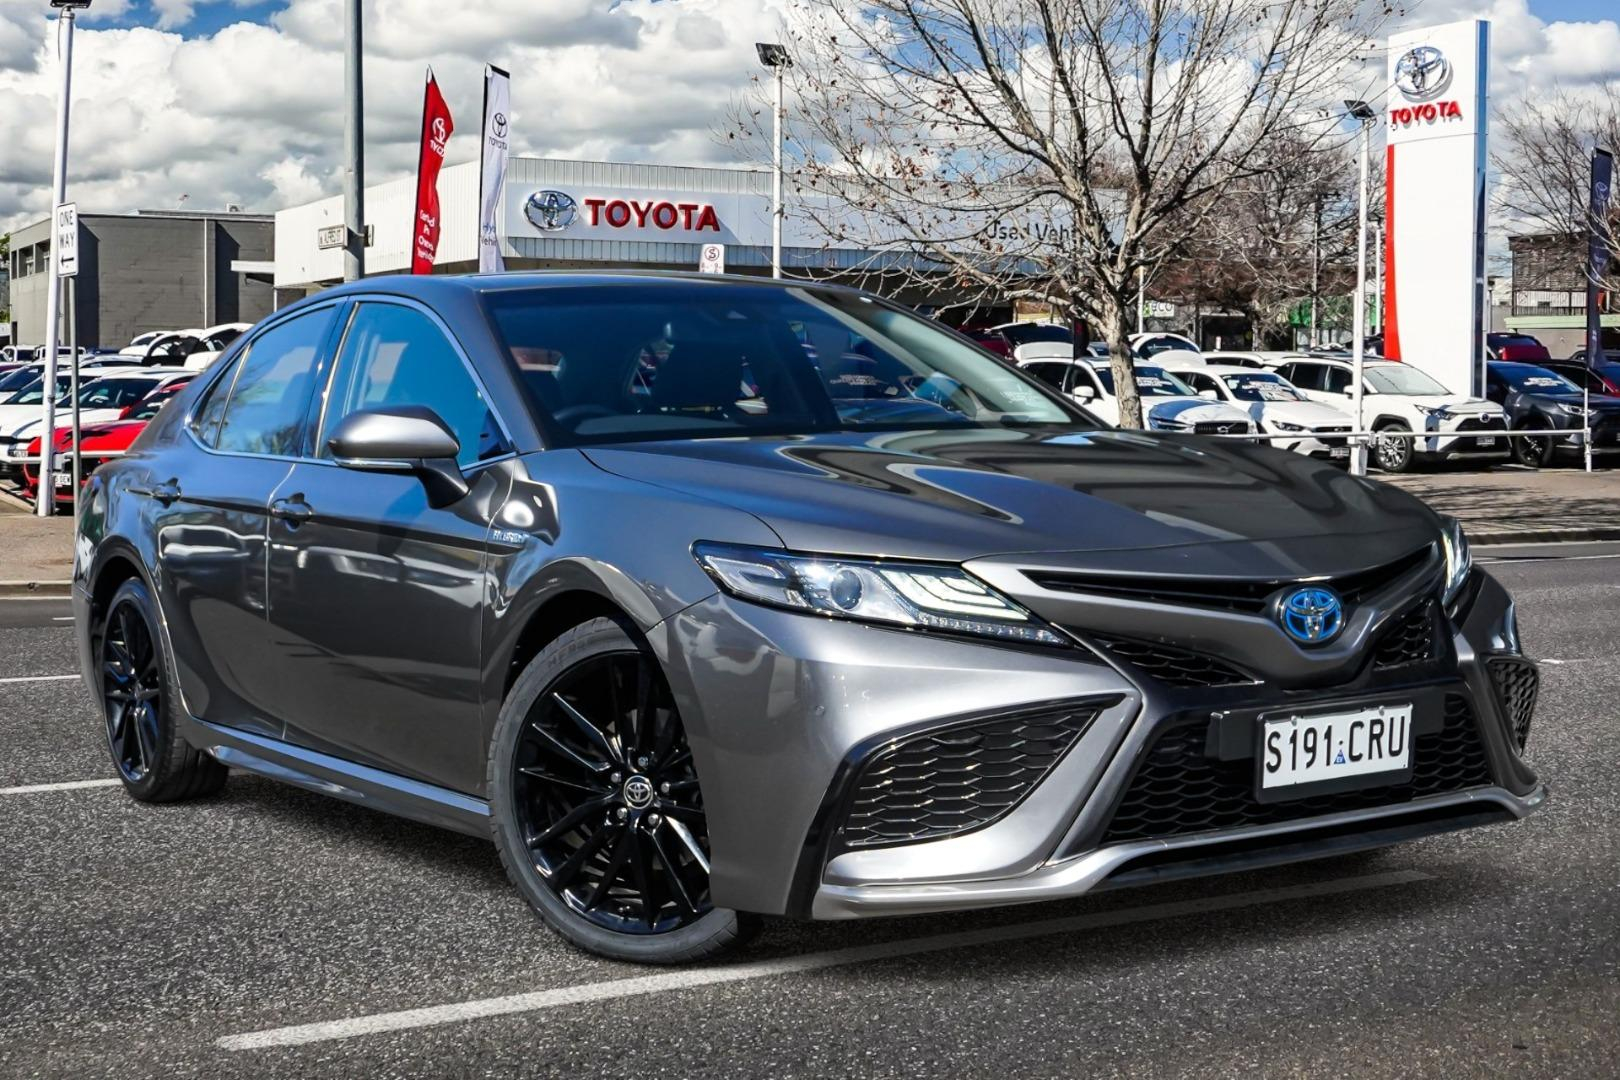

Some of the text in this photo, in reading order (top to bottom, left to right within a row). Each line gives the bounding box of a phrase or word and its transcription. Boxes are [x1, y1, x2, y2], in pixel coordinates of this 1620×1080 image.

[1389, 100, 1463, 126] TOYOTA
[60, 209, 75, 228] ONE
[584, 198, 721, 232] TOYOTA
[59, 232, 75, 249] WAY
[1265, 715, 1406, 773] S191 CRU
